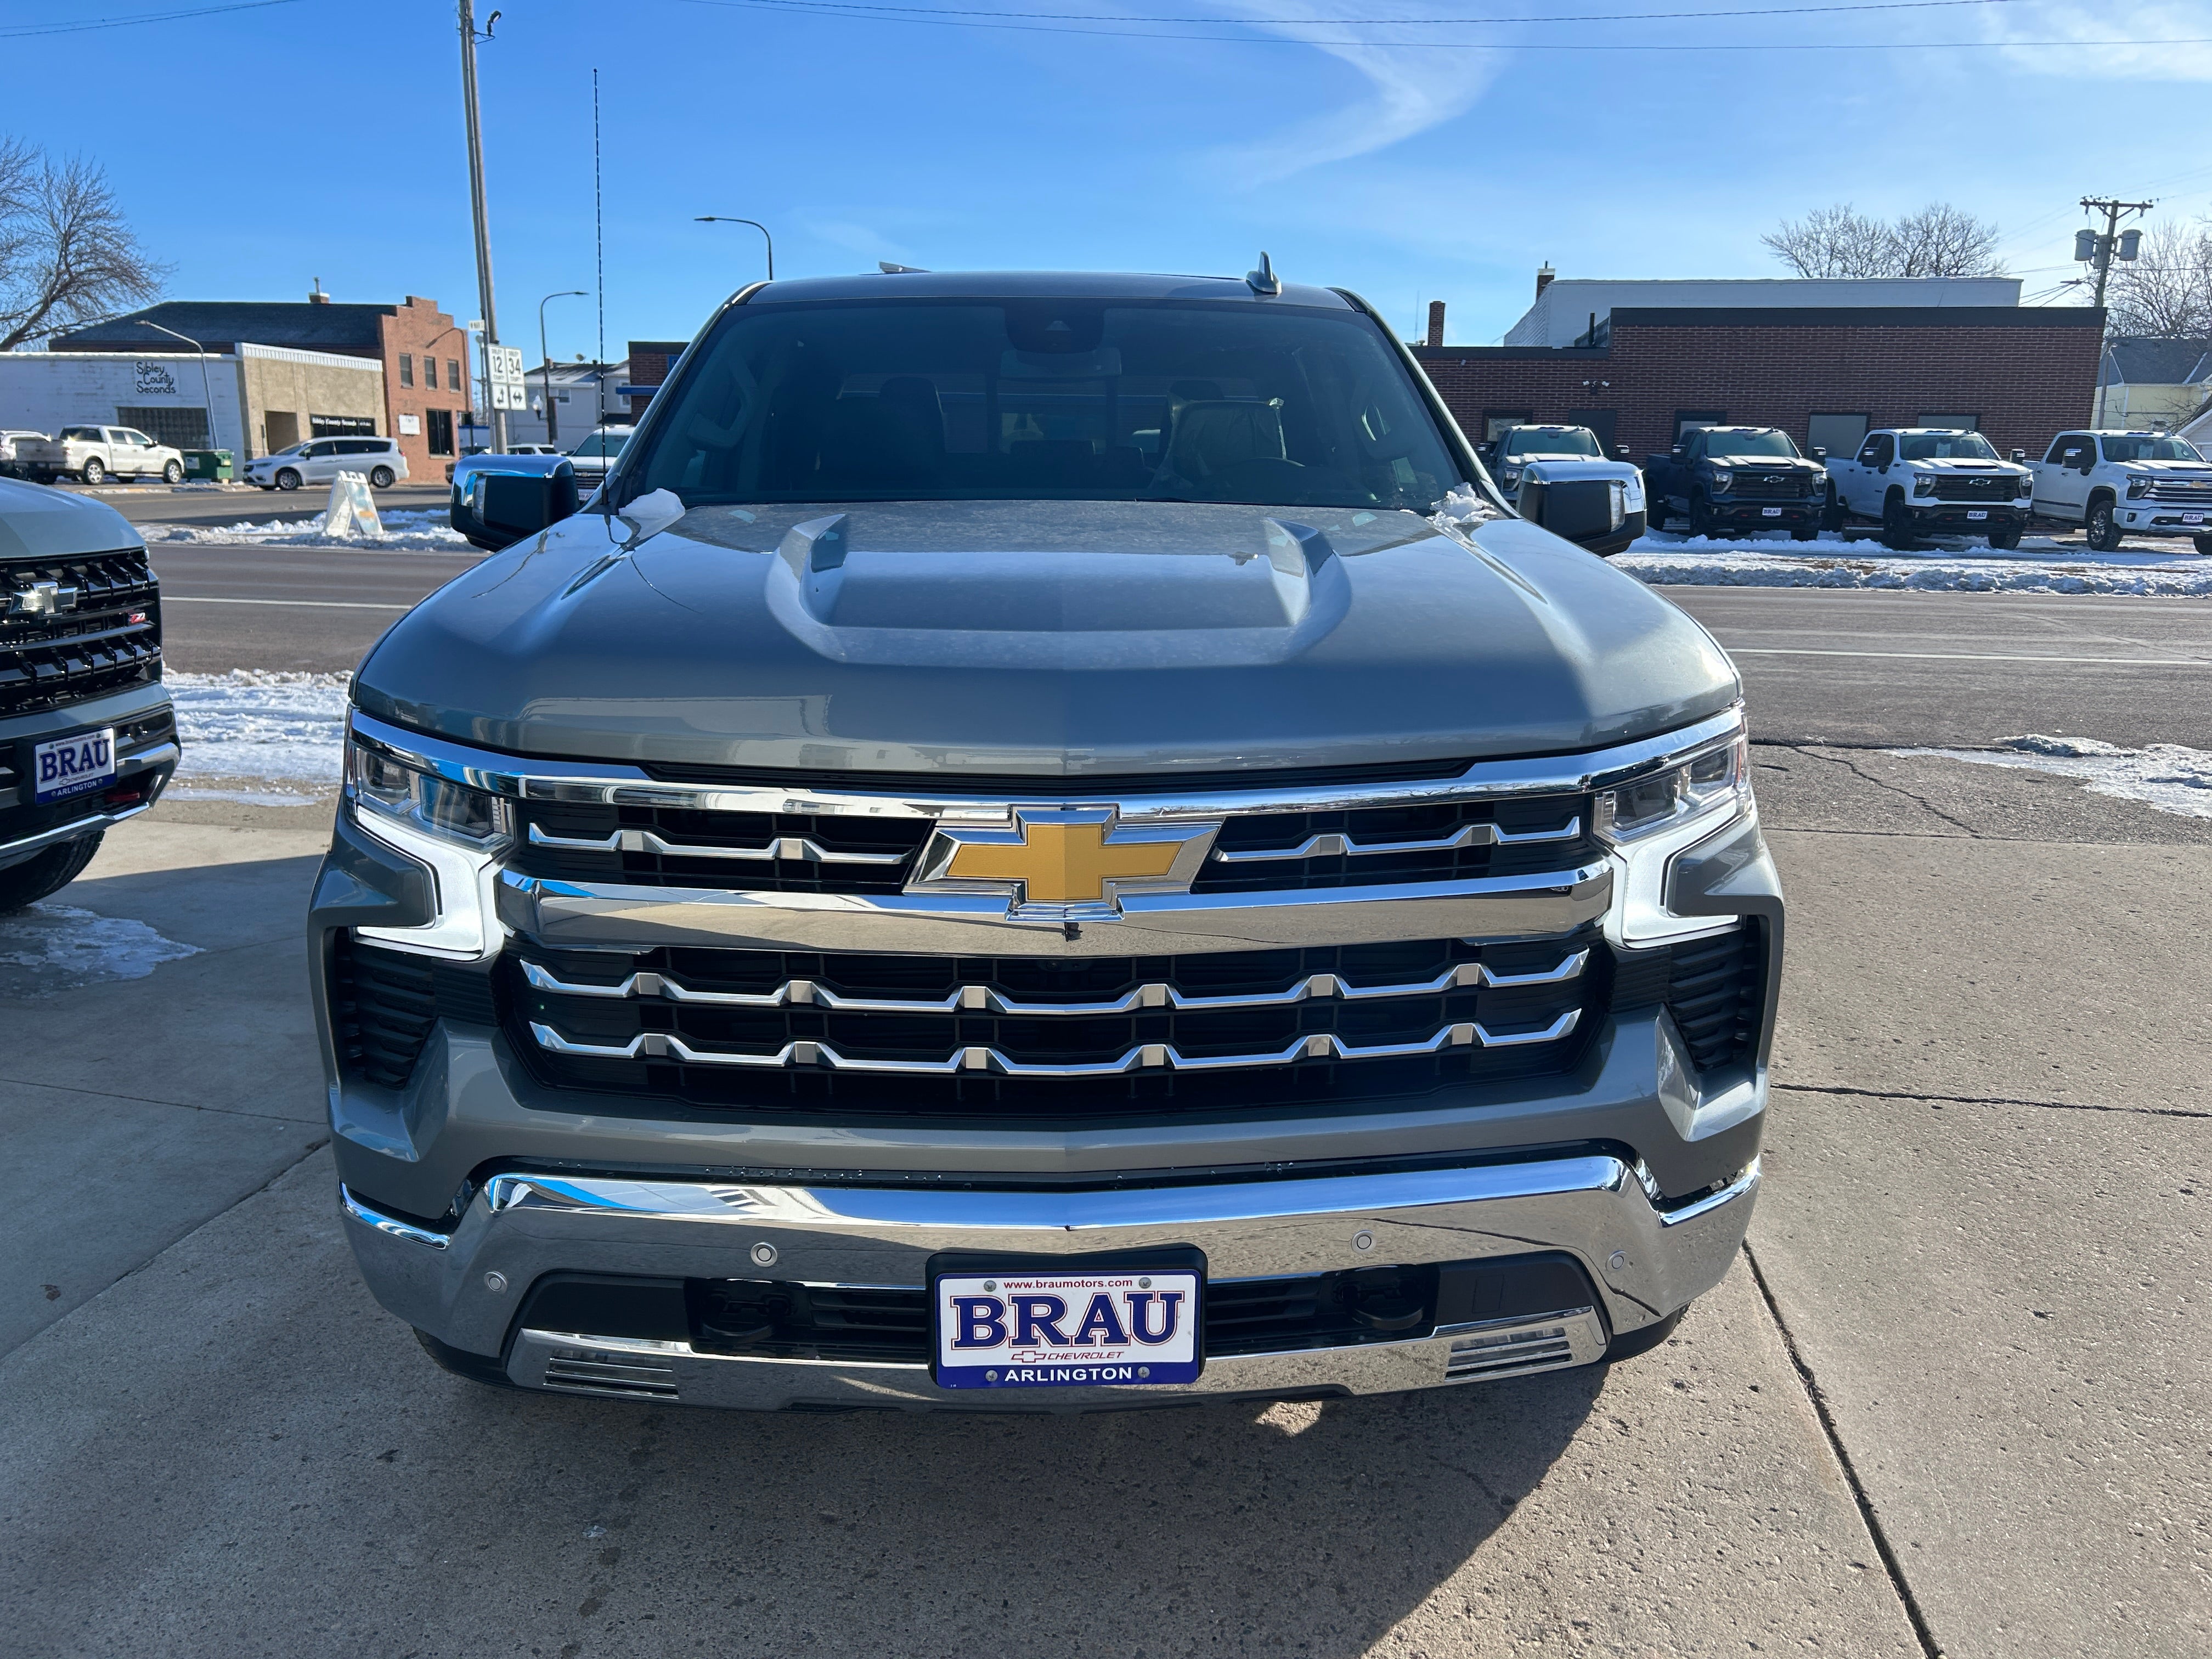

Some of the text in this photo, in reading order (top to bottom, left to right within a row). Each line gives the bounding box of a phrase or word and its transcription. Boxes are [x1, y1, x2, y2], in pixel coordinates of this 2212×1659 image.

[493, 356, 503, 373] 12
[509, 357, 521, 374] 34
[136, 380, 176, 394] Seconds
[143, 372, 174, 386] County
[38, 737, 110, 784] BRAU
[57, 780, 97, 797] ARLINGTON
[1003, 1279, 1132, 1289] www.braumotors.com
[950, 1291, 1185, 1350] BRAU
[1048, 1351, 1125, 1360] CHEVROLET
[1005, 1367, 1132, 1382] ARLINGTON
